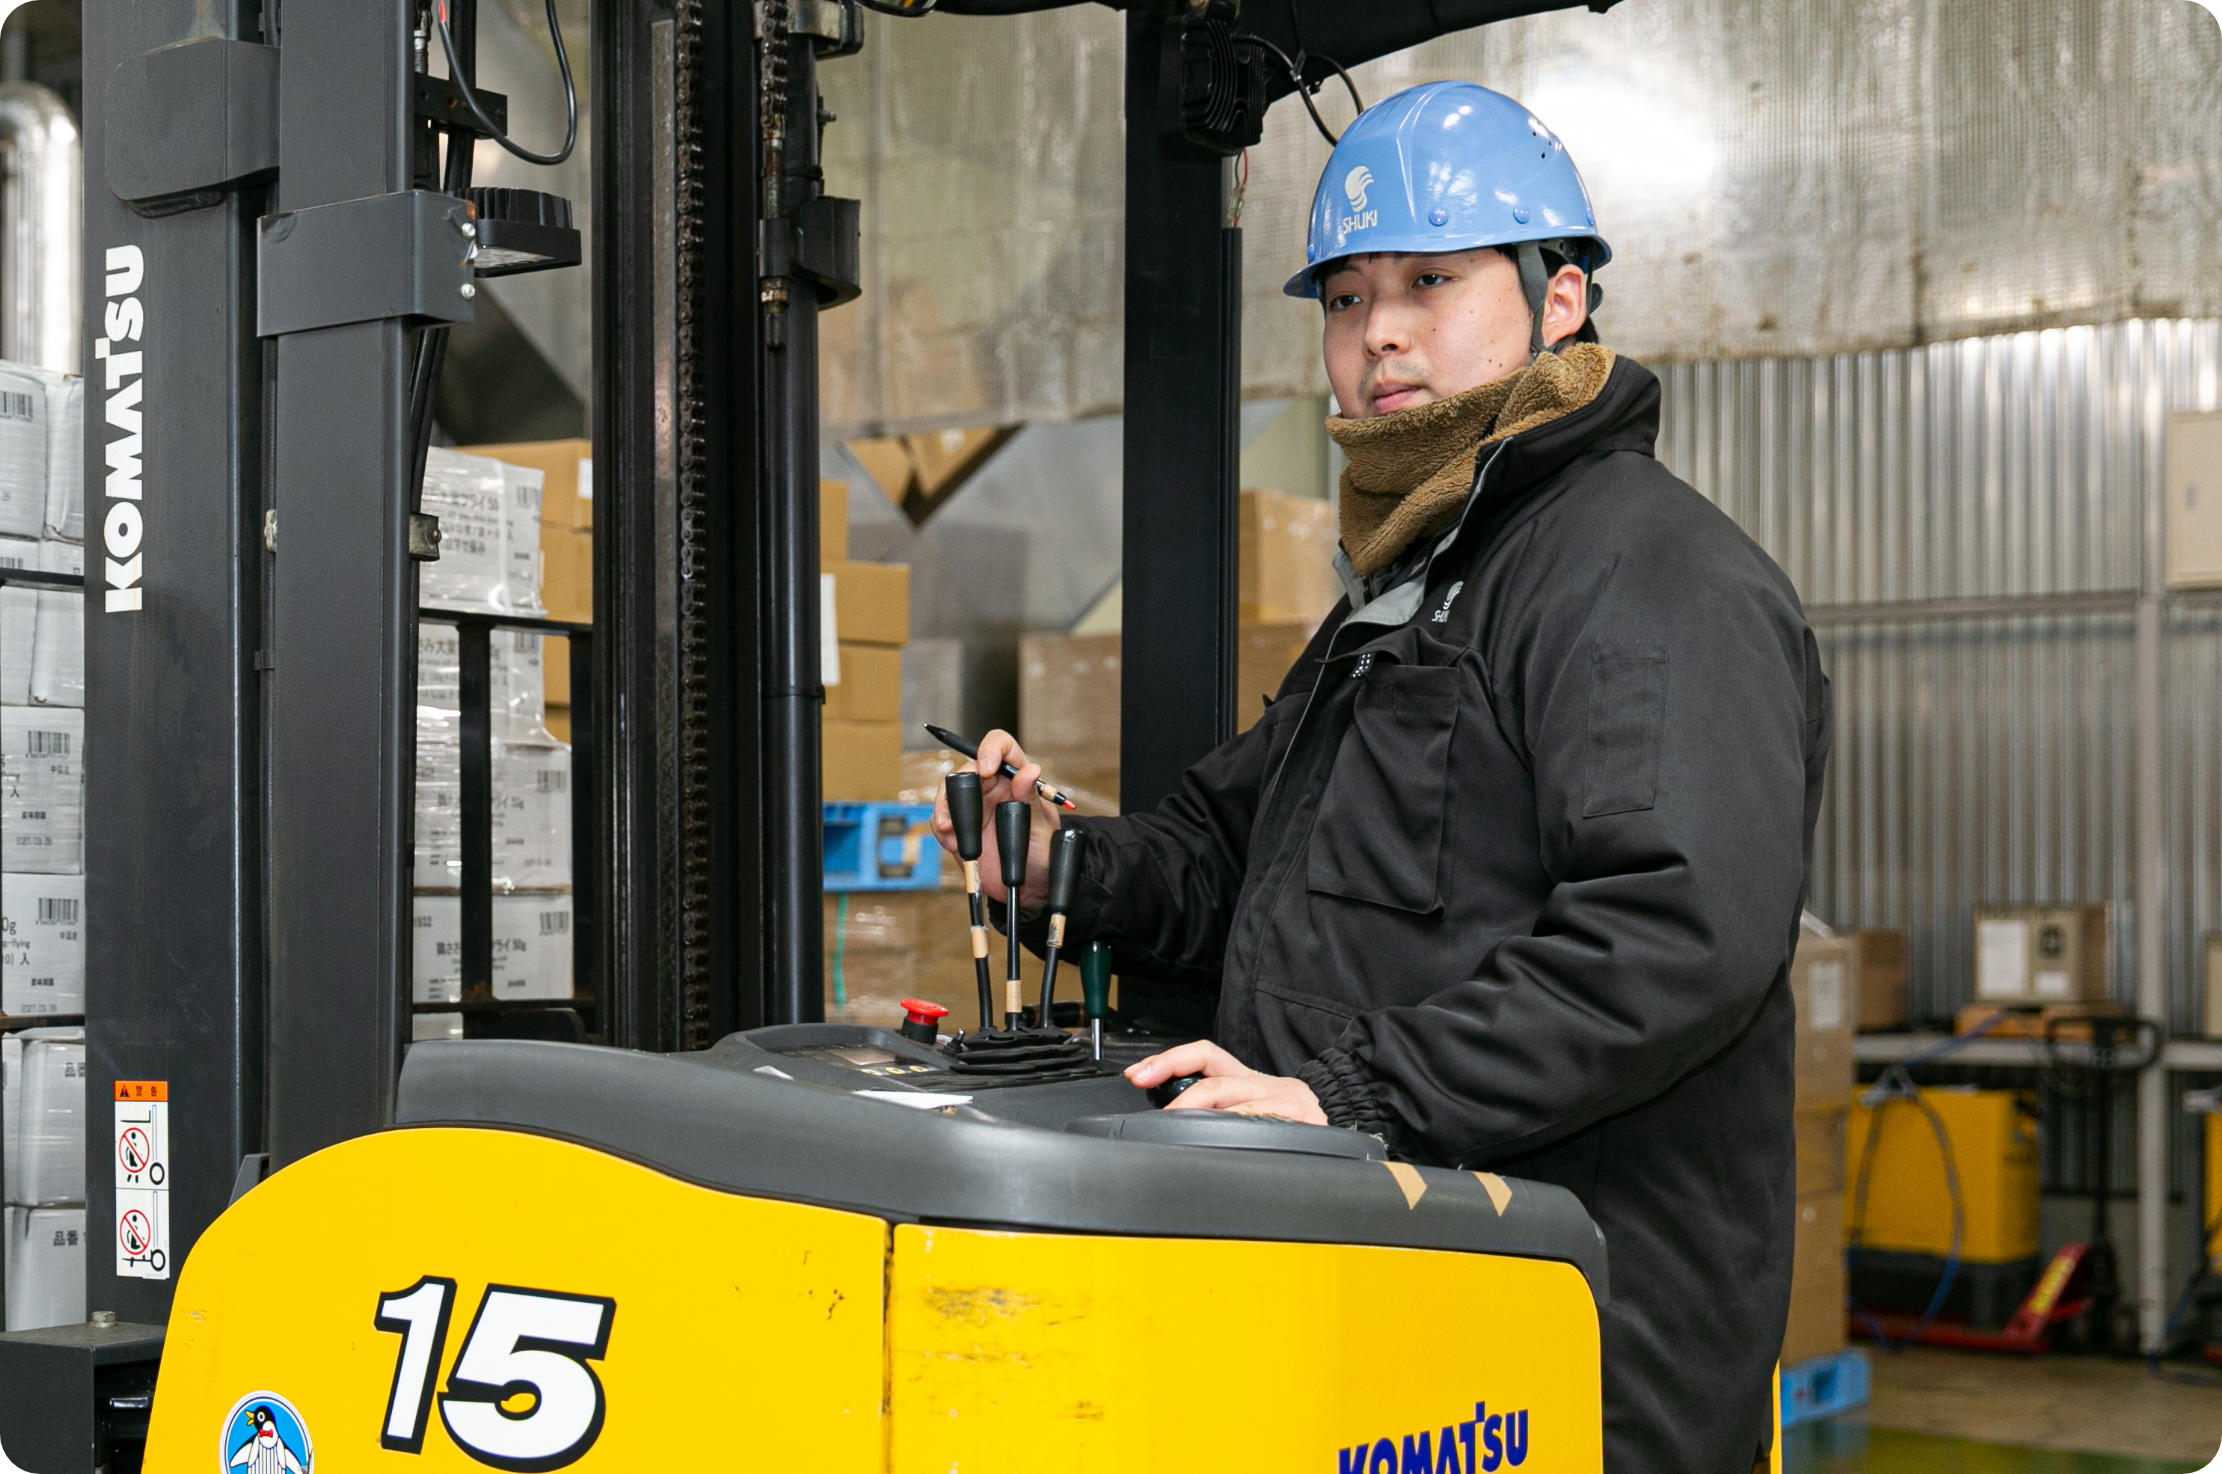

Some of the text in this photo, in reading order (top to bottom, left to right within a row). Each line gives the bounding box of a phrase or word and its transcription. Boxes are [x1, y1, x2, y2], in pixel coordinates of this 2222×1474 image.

[1342, 209, 1378, 235] SHUKI
[95, 244, 144, 613] KOMATSU
[20, 953, 30, 966] 入
[373, 1274, 617, 1474] 15
[1337, 1400, 1528, 1474] KOMATSU
